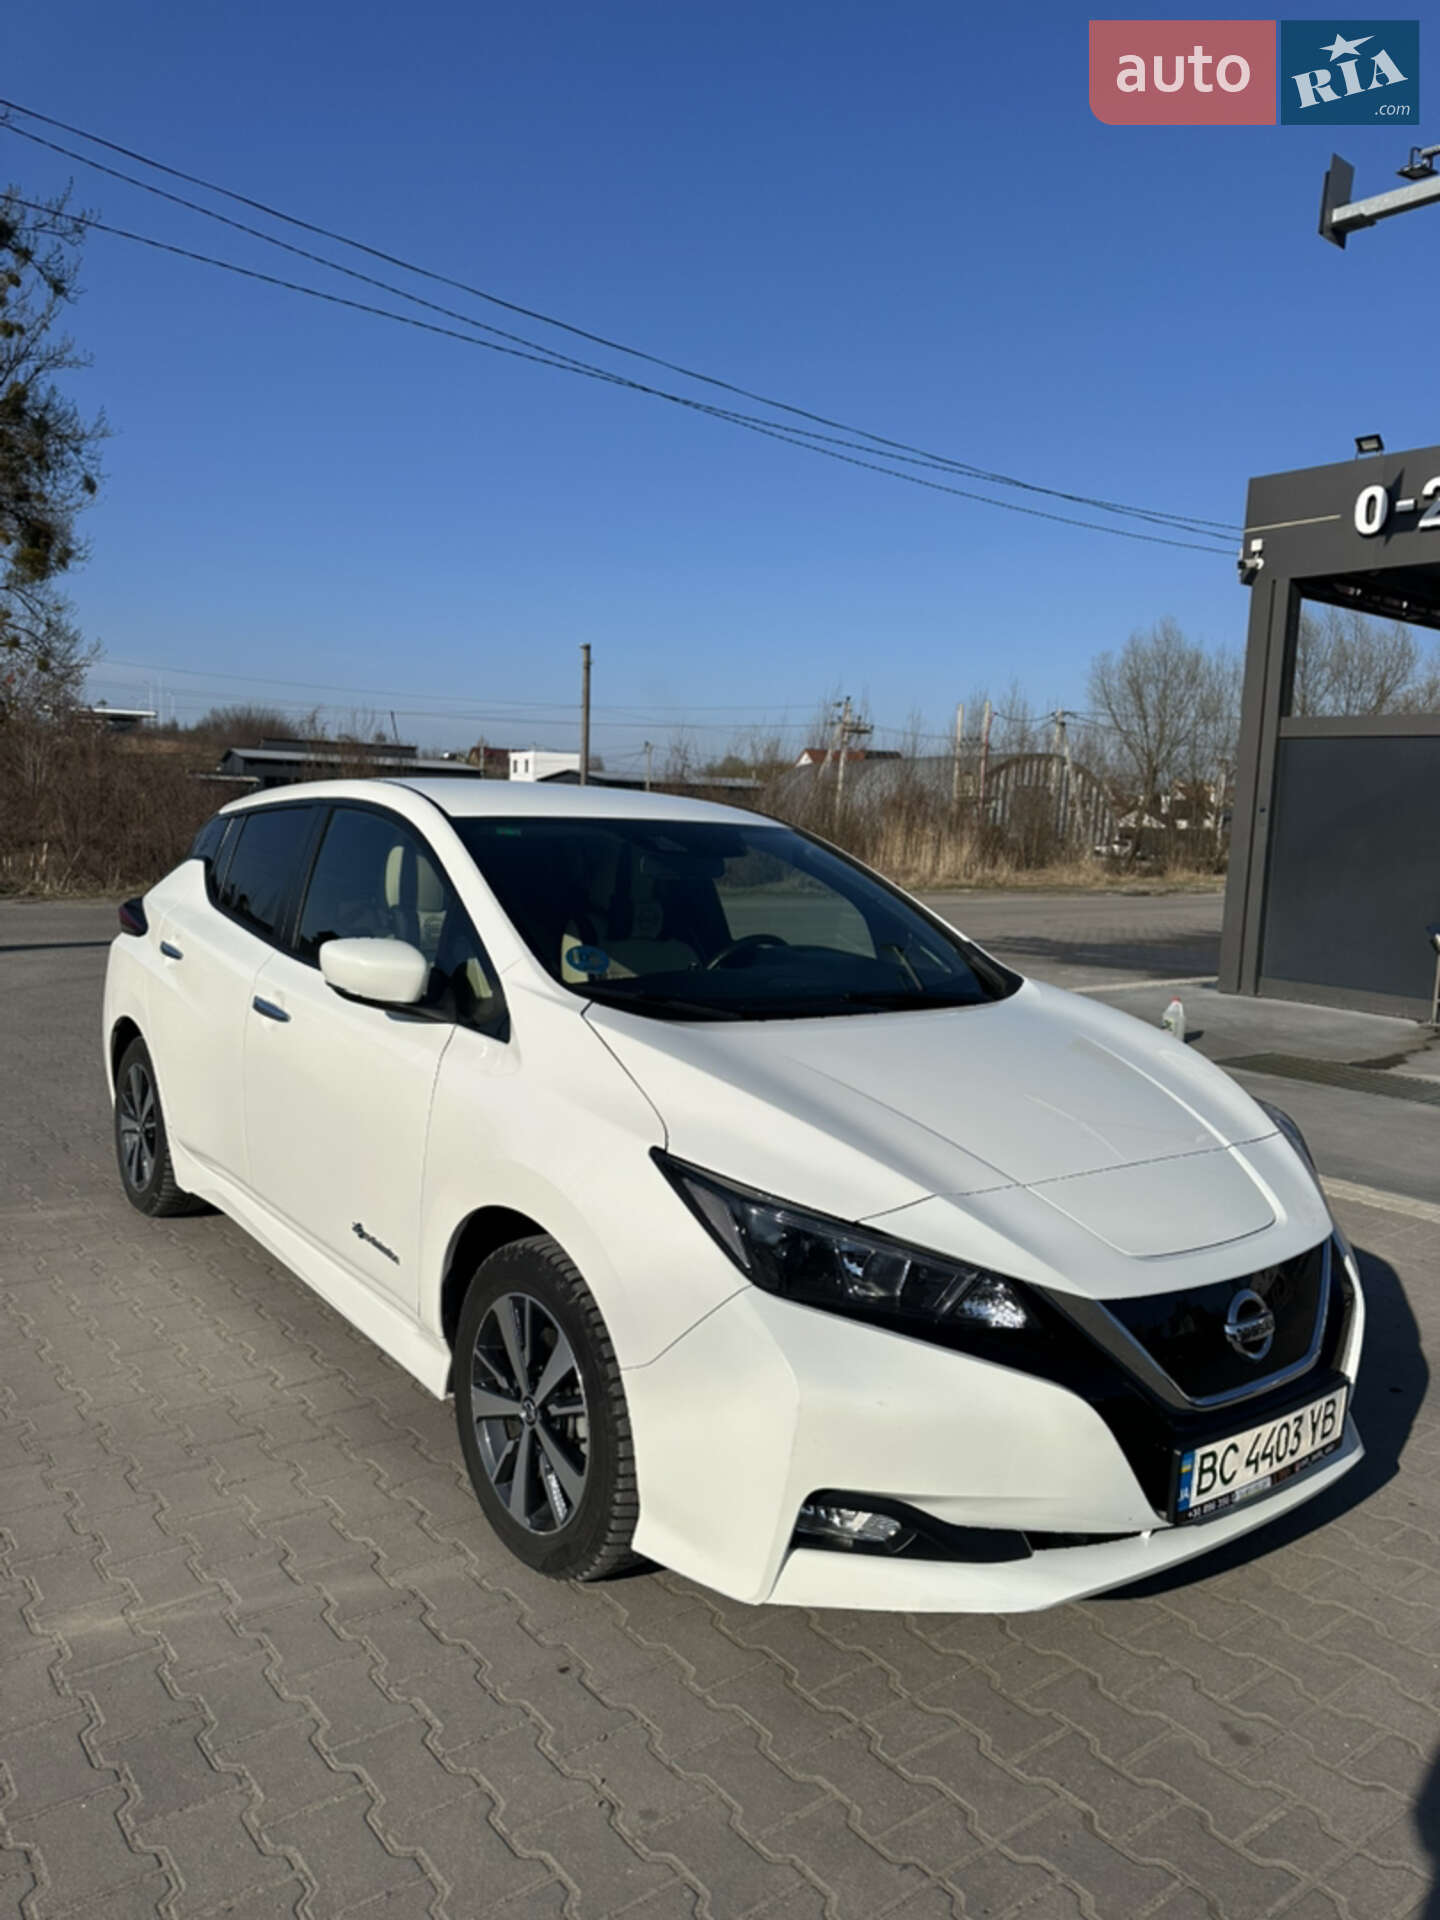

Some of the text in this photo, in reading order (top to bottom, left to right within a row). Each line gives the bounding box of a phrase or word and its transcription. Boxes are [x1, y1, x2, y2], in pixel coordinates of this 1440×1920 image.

[1196, 1443, 1239, 1496] BC
[1245, 1416, 1304, 1474] 4403
[1310, 1399, 1337, 1446] YB
